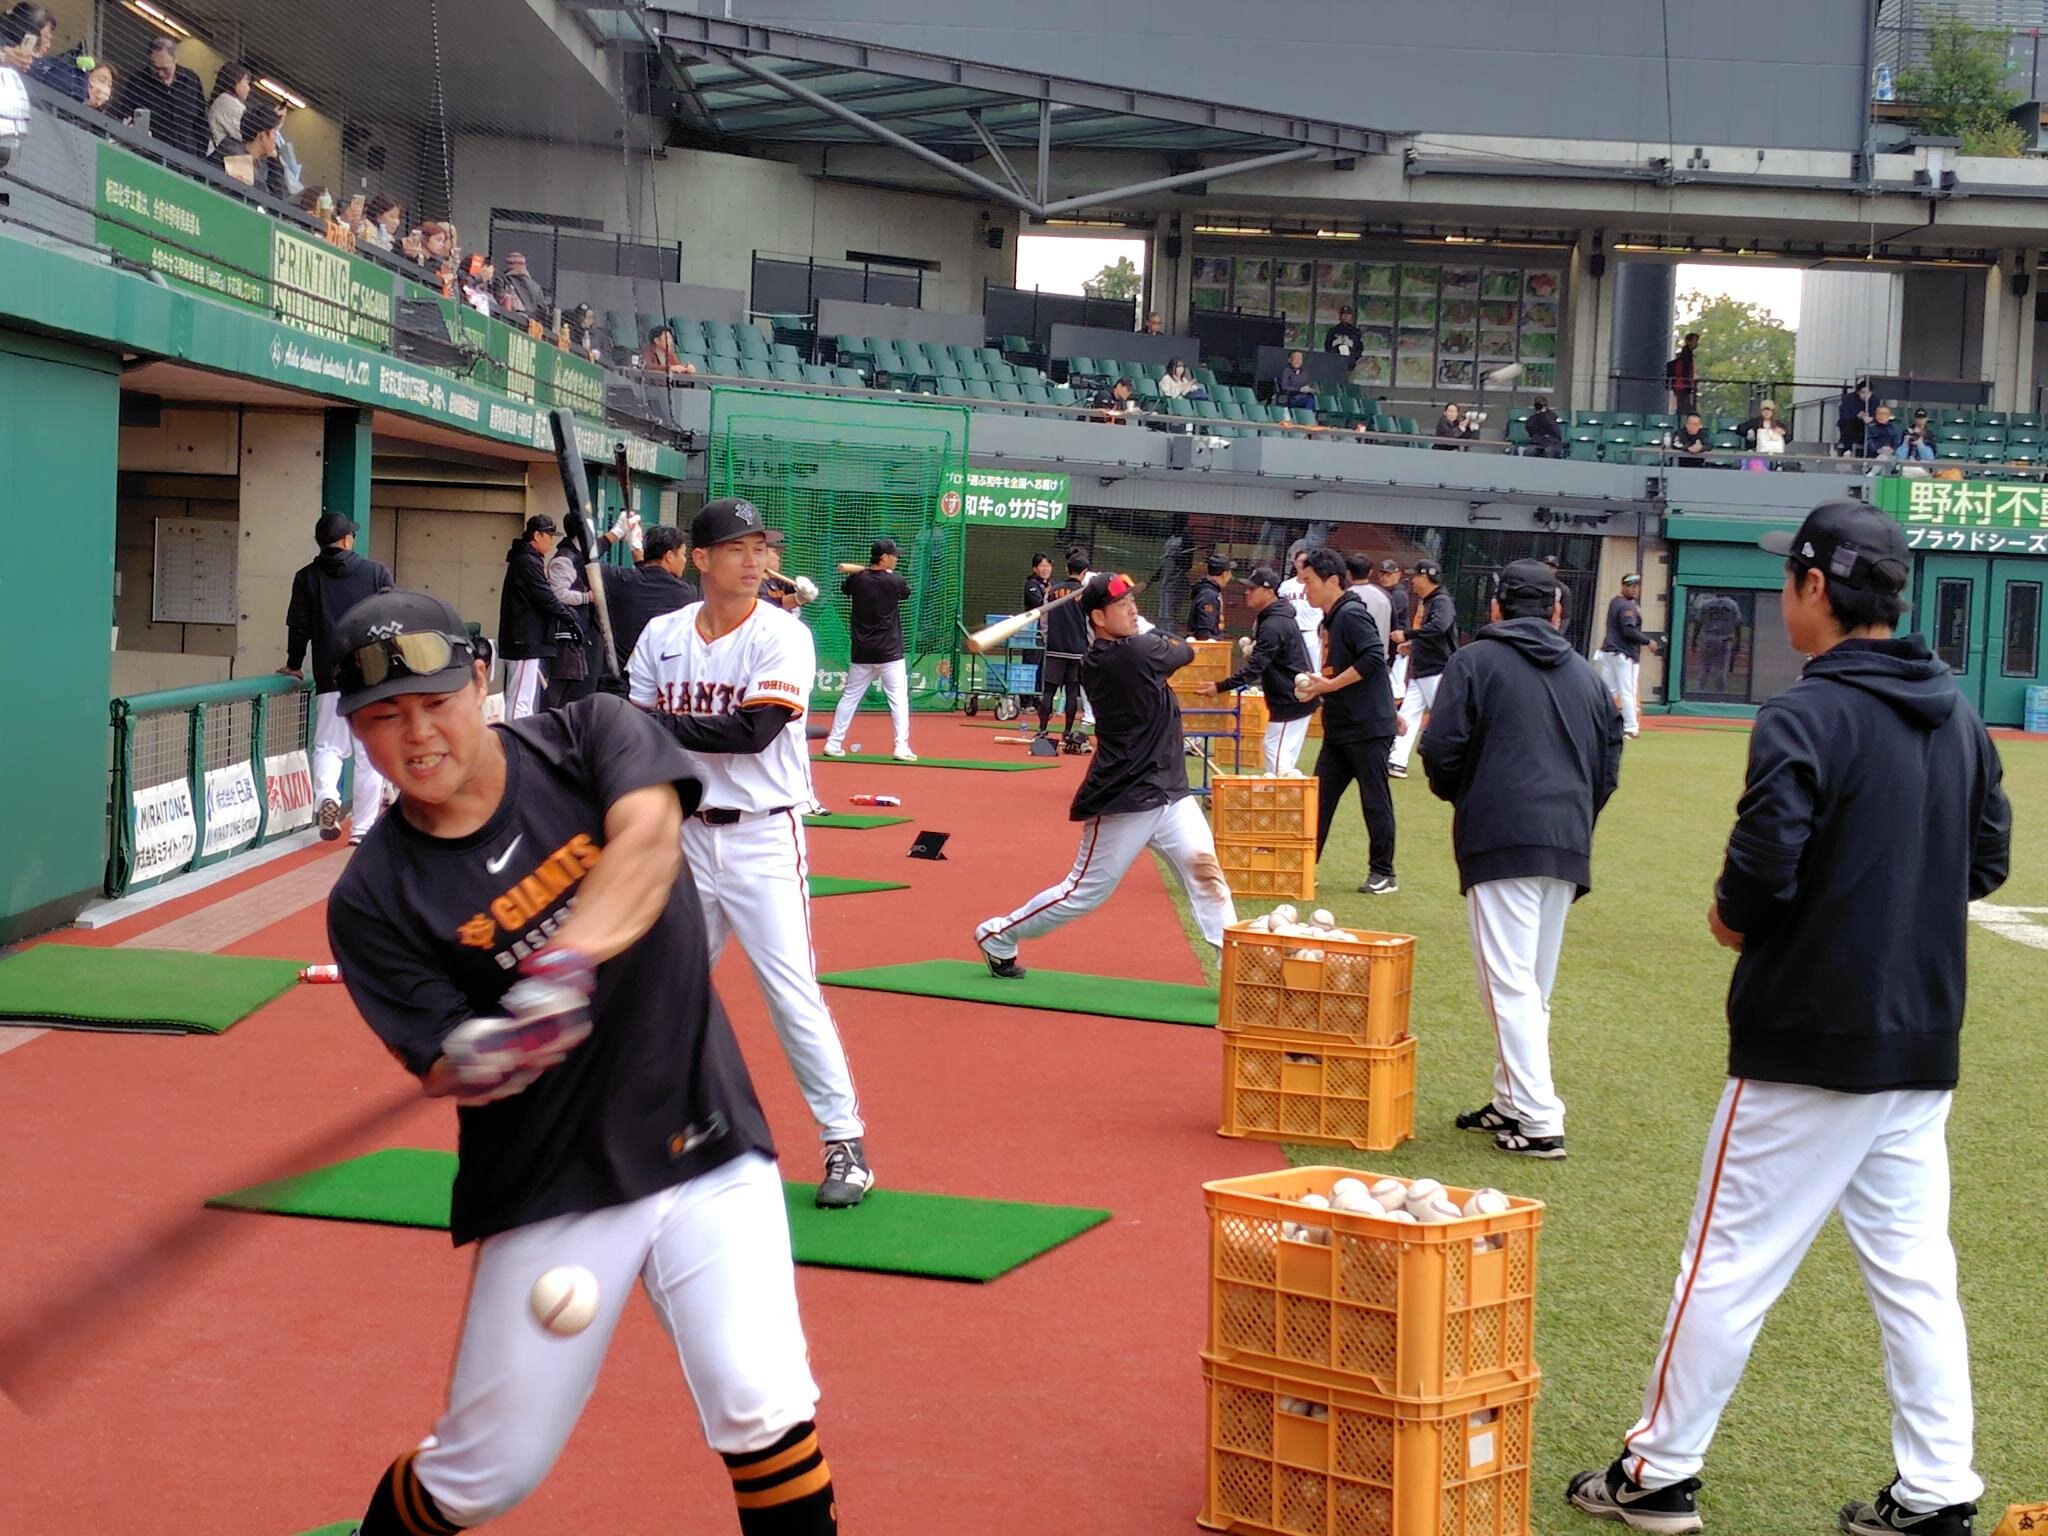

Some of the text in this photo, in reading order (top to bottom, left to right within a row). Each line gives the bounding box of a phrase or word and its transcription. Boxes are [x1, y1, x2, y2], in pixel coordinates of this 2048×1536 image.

[277, 237, 348, 303] PRINTING
[965, 495, 1063, 520] 和牛のサガミヤ
[1909, 482, 2048, 527] 野村不
[279, 769, 312, 813] KIRIN
[491, 832, 603, 931] GIANTS
